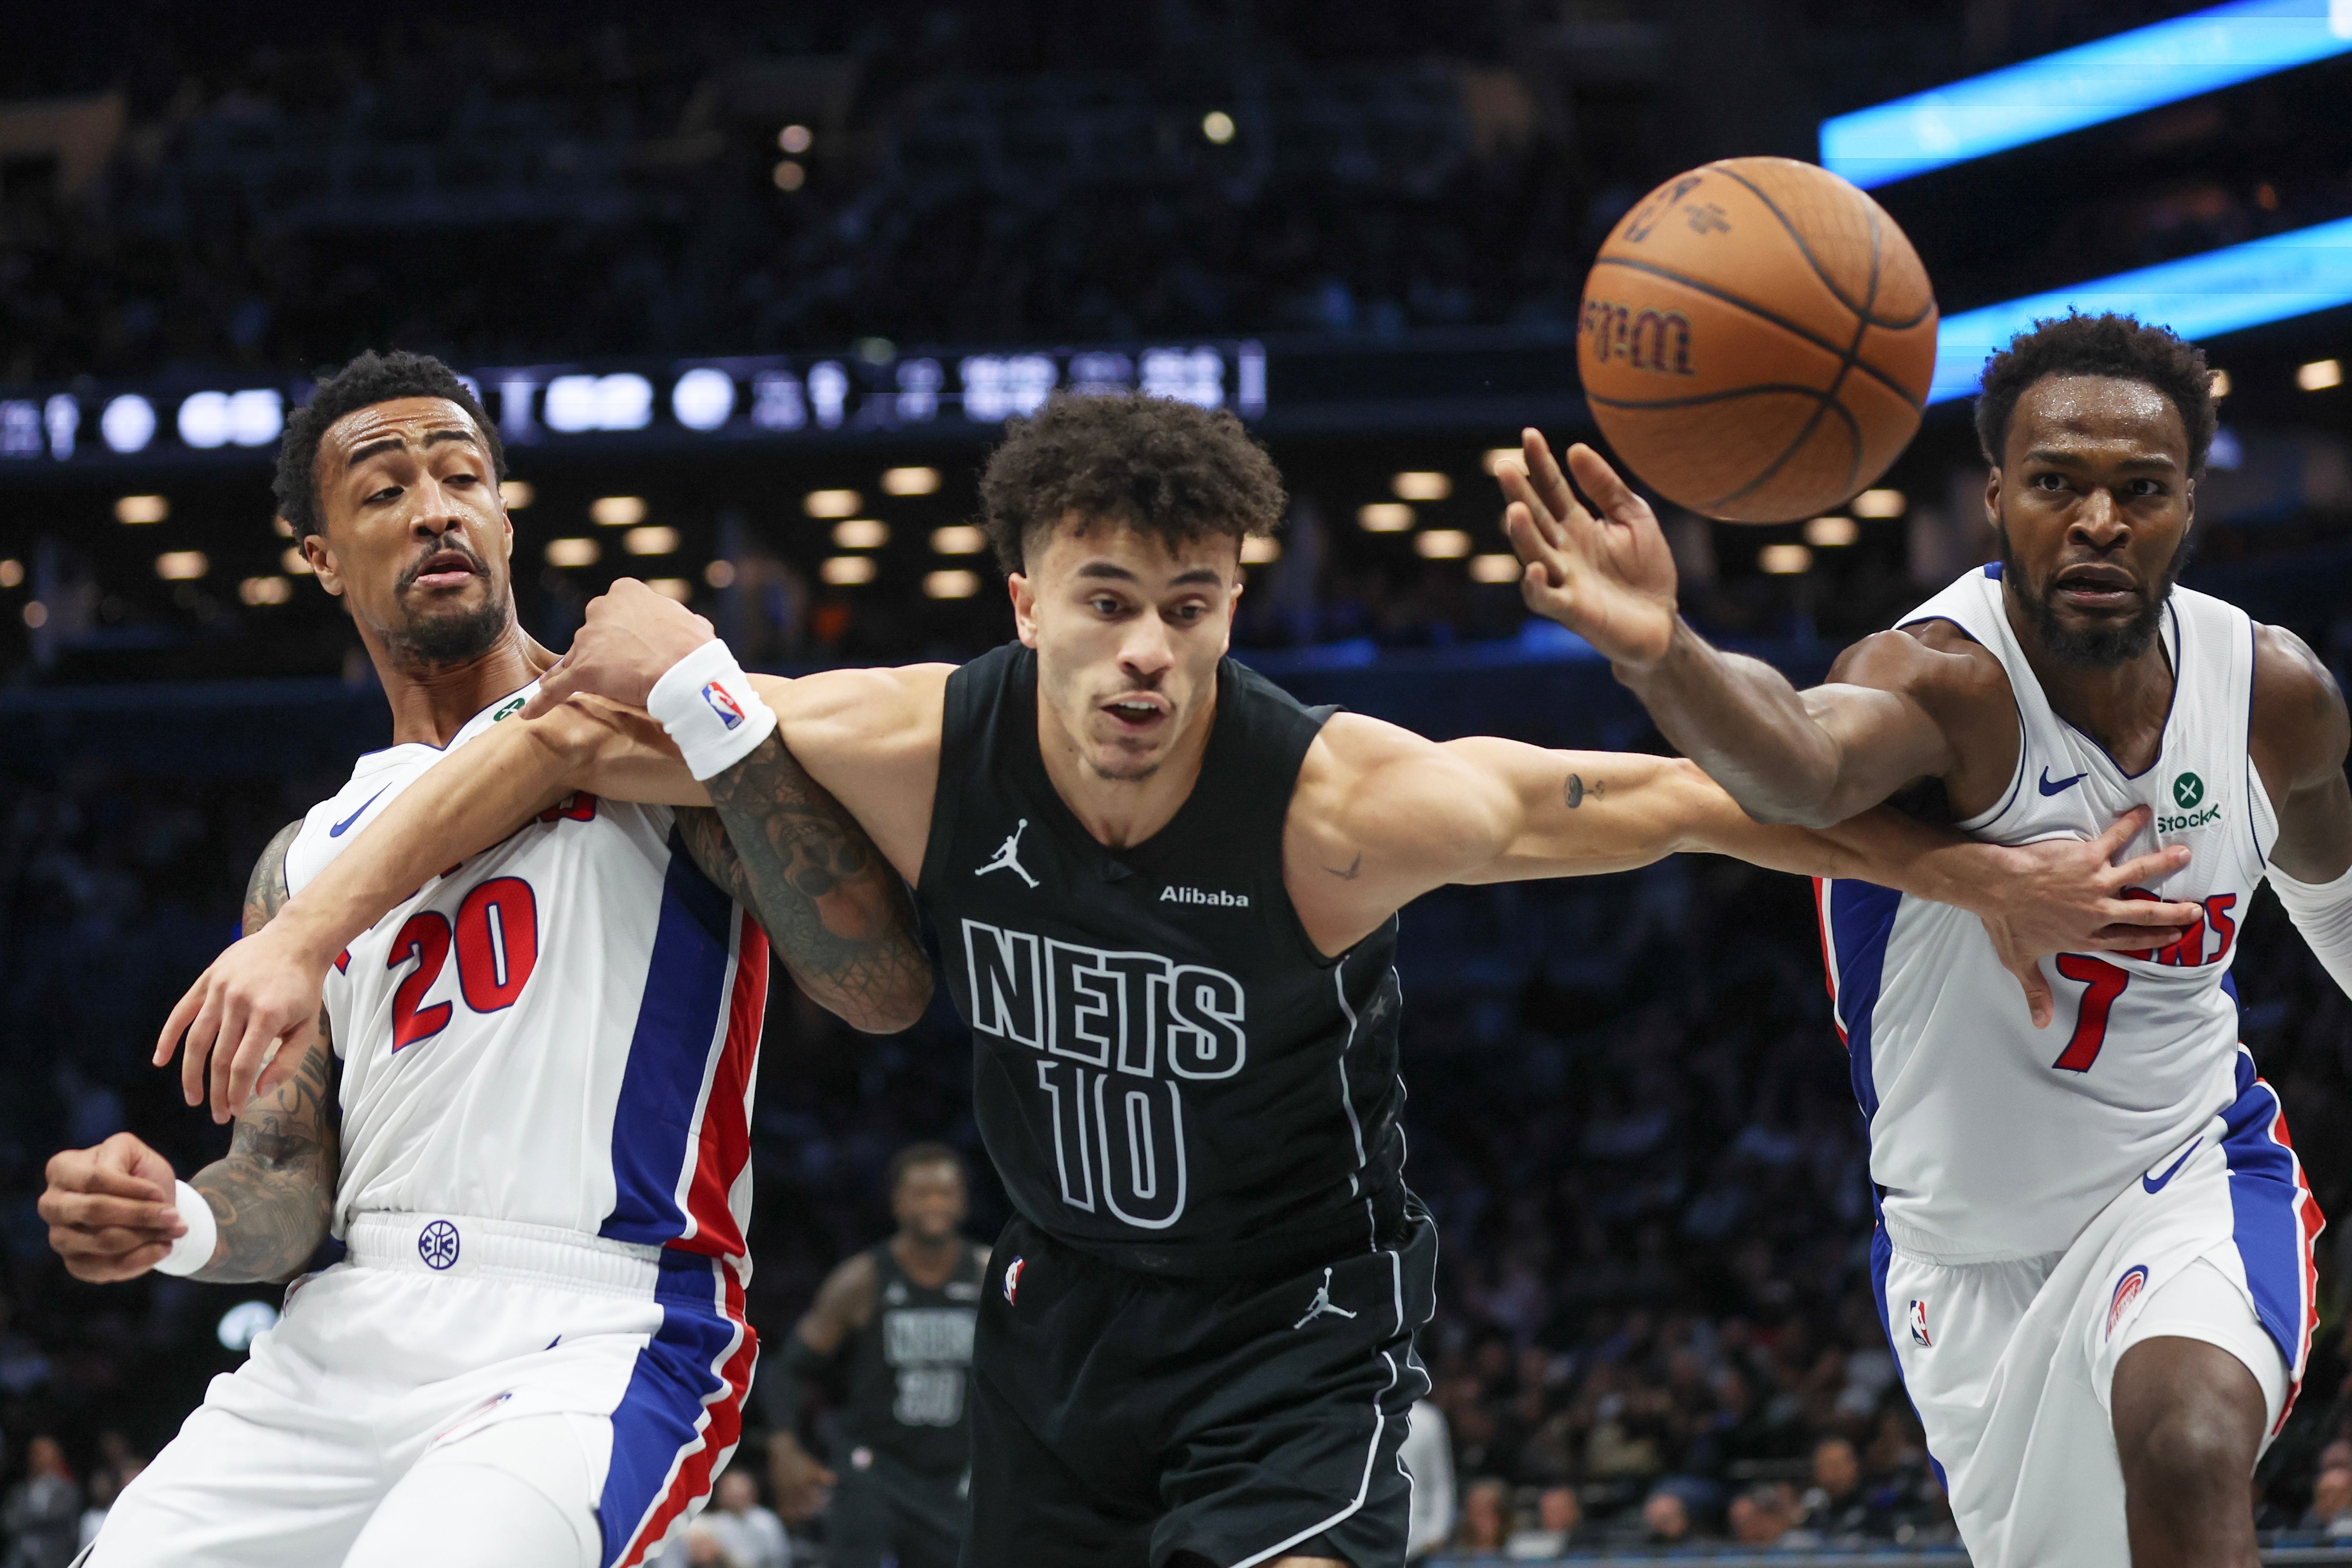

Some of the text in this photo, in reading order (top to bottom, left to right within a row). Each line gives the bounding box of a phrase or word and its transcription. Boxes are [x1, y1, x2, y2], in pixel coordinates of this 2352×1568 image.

[386, 876, 538, 1055] 20
[1159, 885, 1249, 907] Alibaba
[961, 918, 1245, 1080] NETS
[2052, 952, 2129, 1073] 7
[1036, 1060, 1187, 1230] 10
